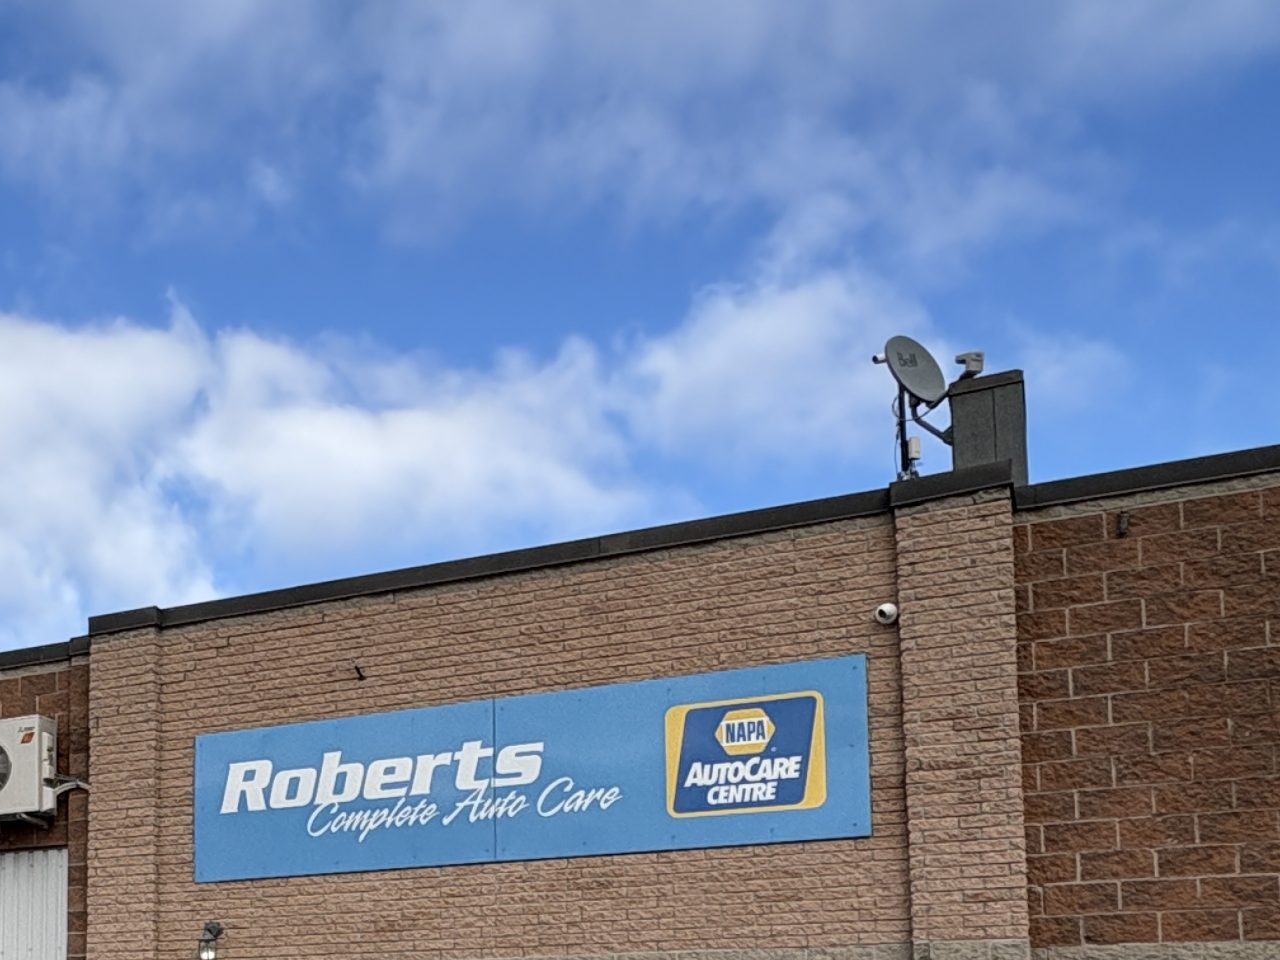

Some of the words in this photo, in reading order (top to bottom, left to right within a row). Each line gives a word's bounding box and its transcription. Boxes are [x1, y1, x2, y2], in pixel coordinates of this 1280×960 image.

[725, 719, 766, 743] NAPA
[220, 740, 544, 814] Roberts
[707, 781, 778, 805] CENTRE
[307, 797, 440, 842] Complete
[442, 778, 530, 826] Auto
[536, 776, 623, 817] Care
